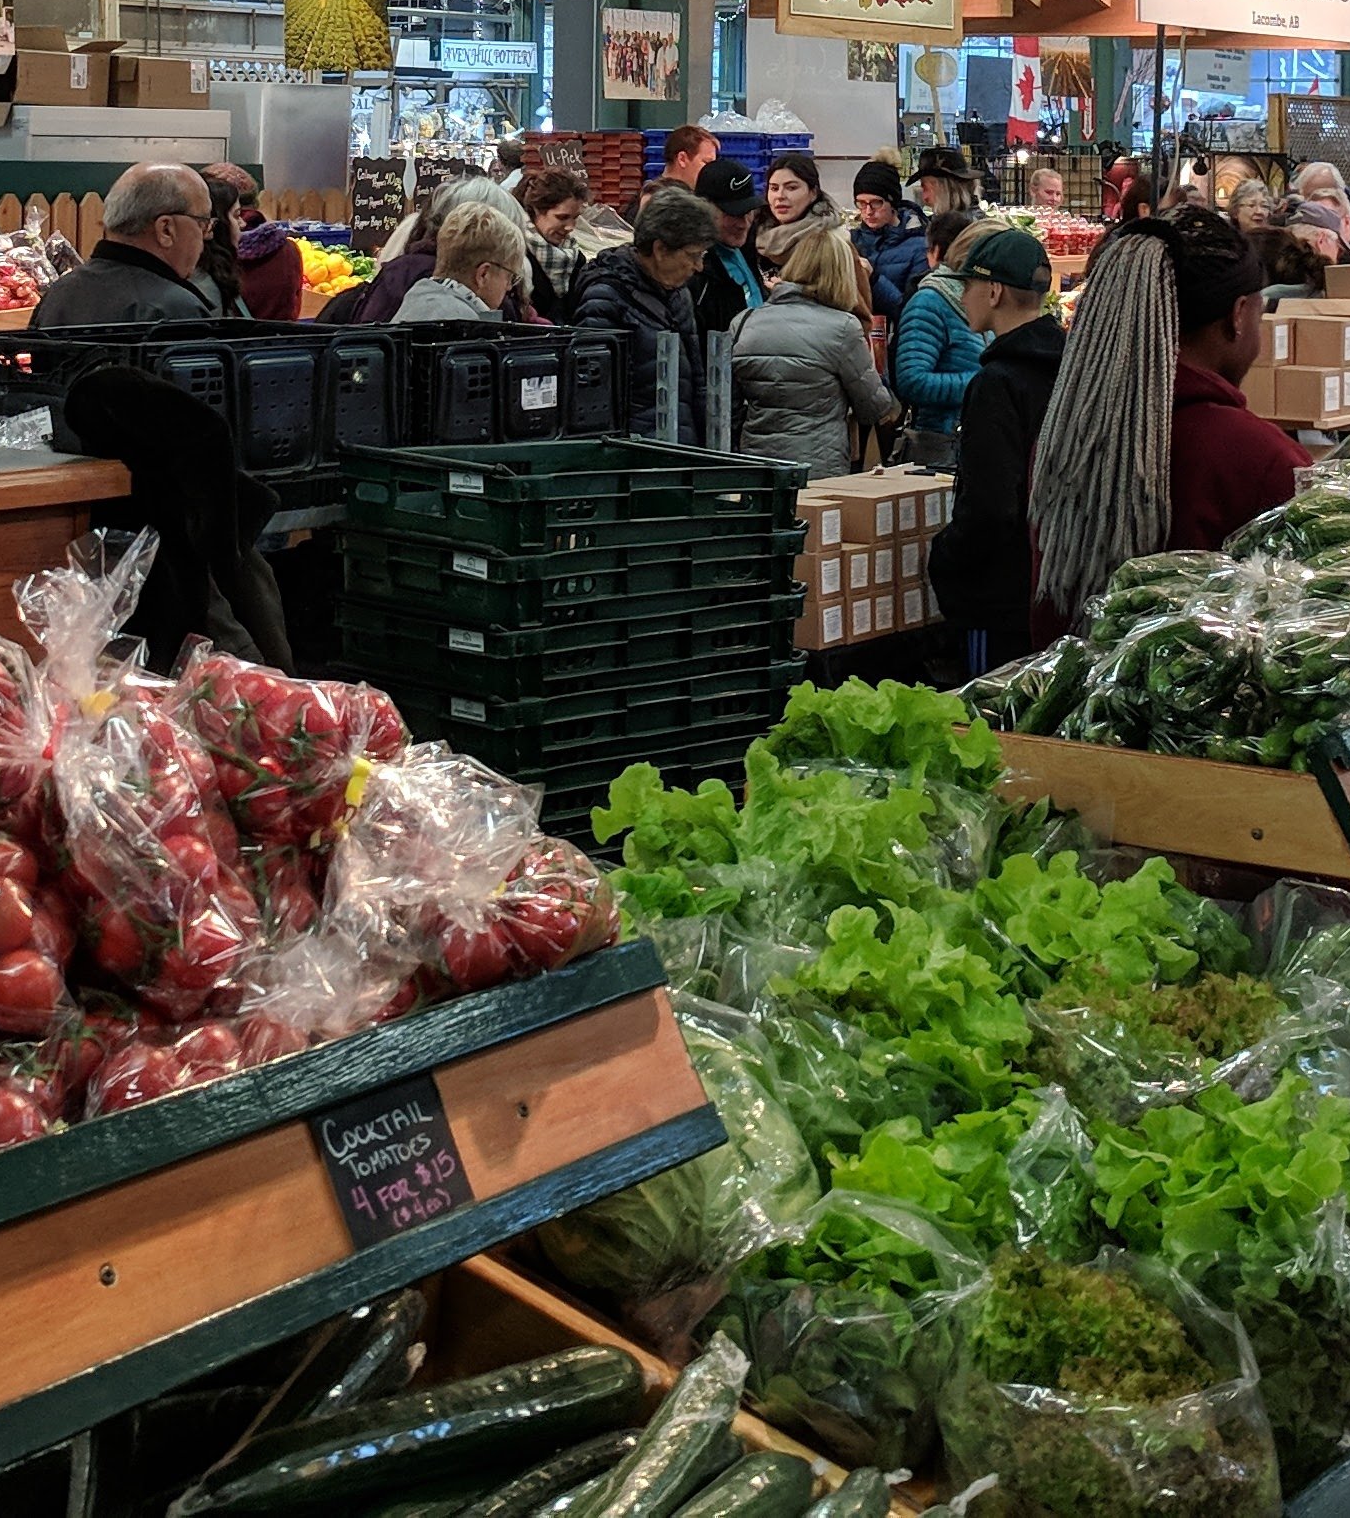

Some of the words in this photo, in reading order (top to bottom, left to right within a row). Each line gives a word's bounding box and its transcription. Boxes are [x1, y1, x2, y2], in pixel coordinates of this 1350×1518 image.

[1289, 15, 1300, 29] AB
[322, 1100, 434, 1159] COCKTAIL
[351, 1185, 378, 1220] 4
[376, 1178, 421, 1212] FOR
